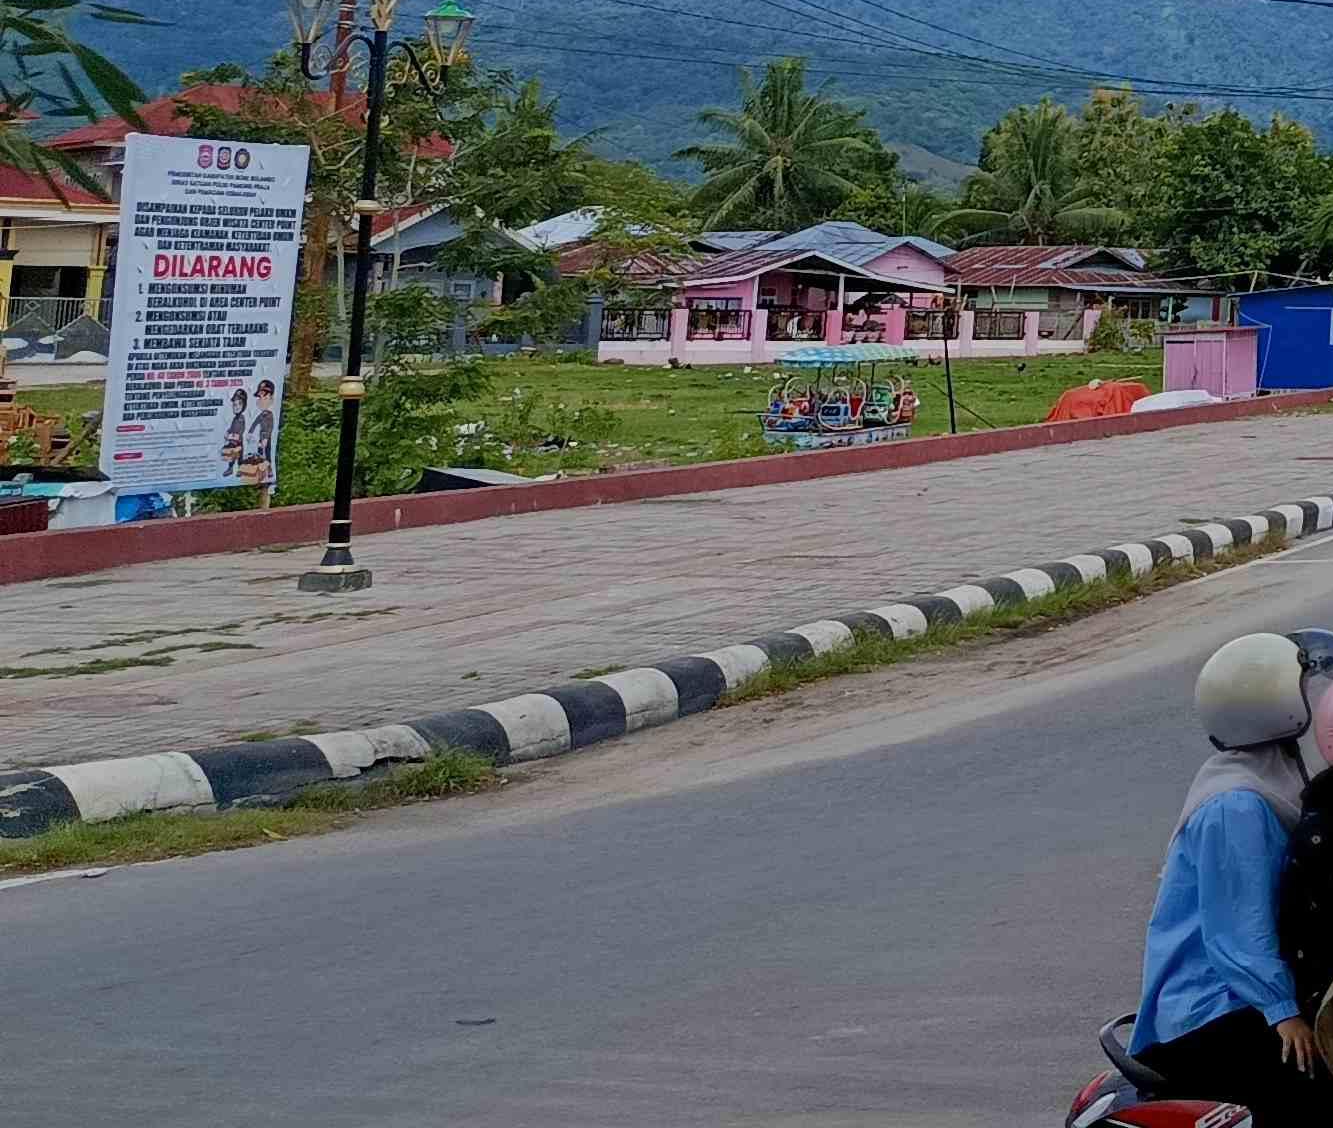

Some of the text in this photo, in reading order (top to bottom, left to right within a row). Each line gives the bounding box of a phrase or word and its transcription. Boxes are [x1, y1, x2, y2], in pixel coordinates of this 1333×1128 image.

[251, 219, 275, 229] CENTER
[153, 254, 272, 279] DILARANG
[209, 297, 228, 307] AREA
[230, 297, 257, 307] CENTER
[259, 296, 281, 307] POINT
[207, 311, 228, 321] ATAU
